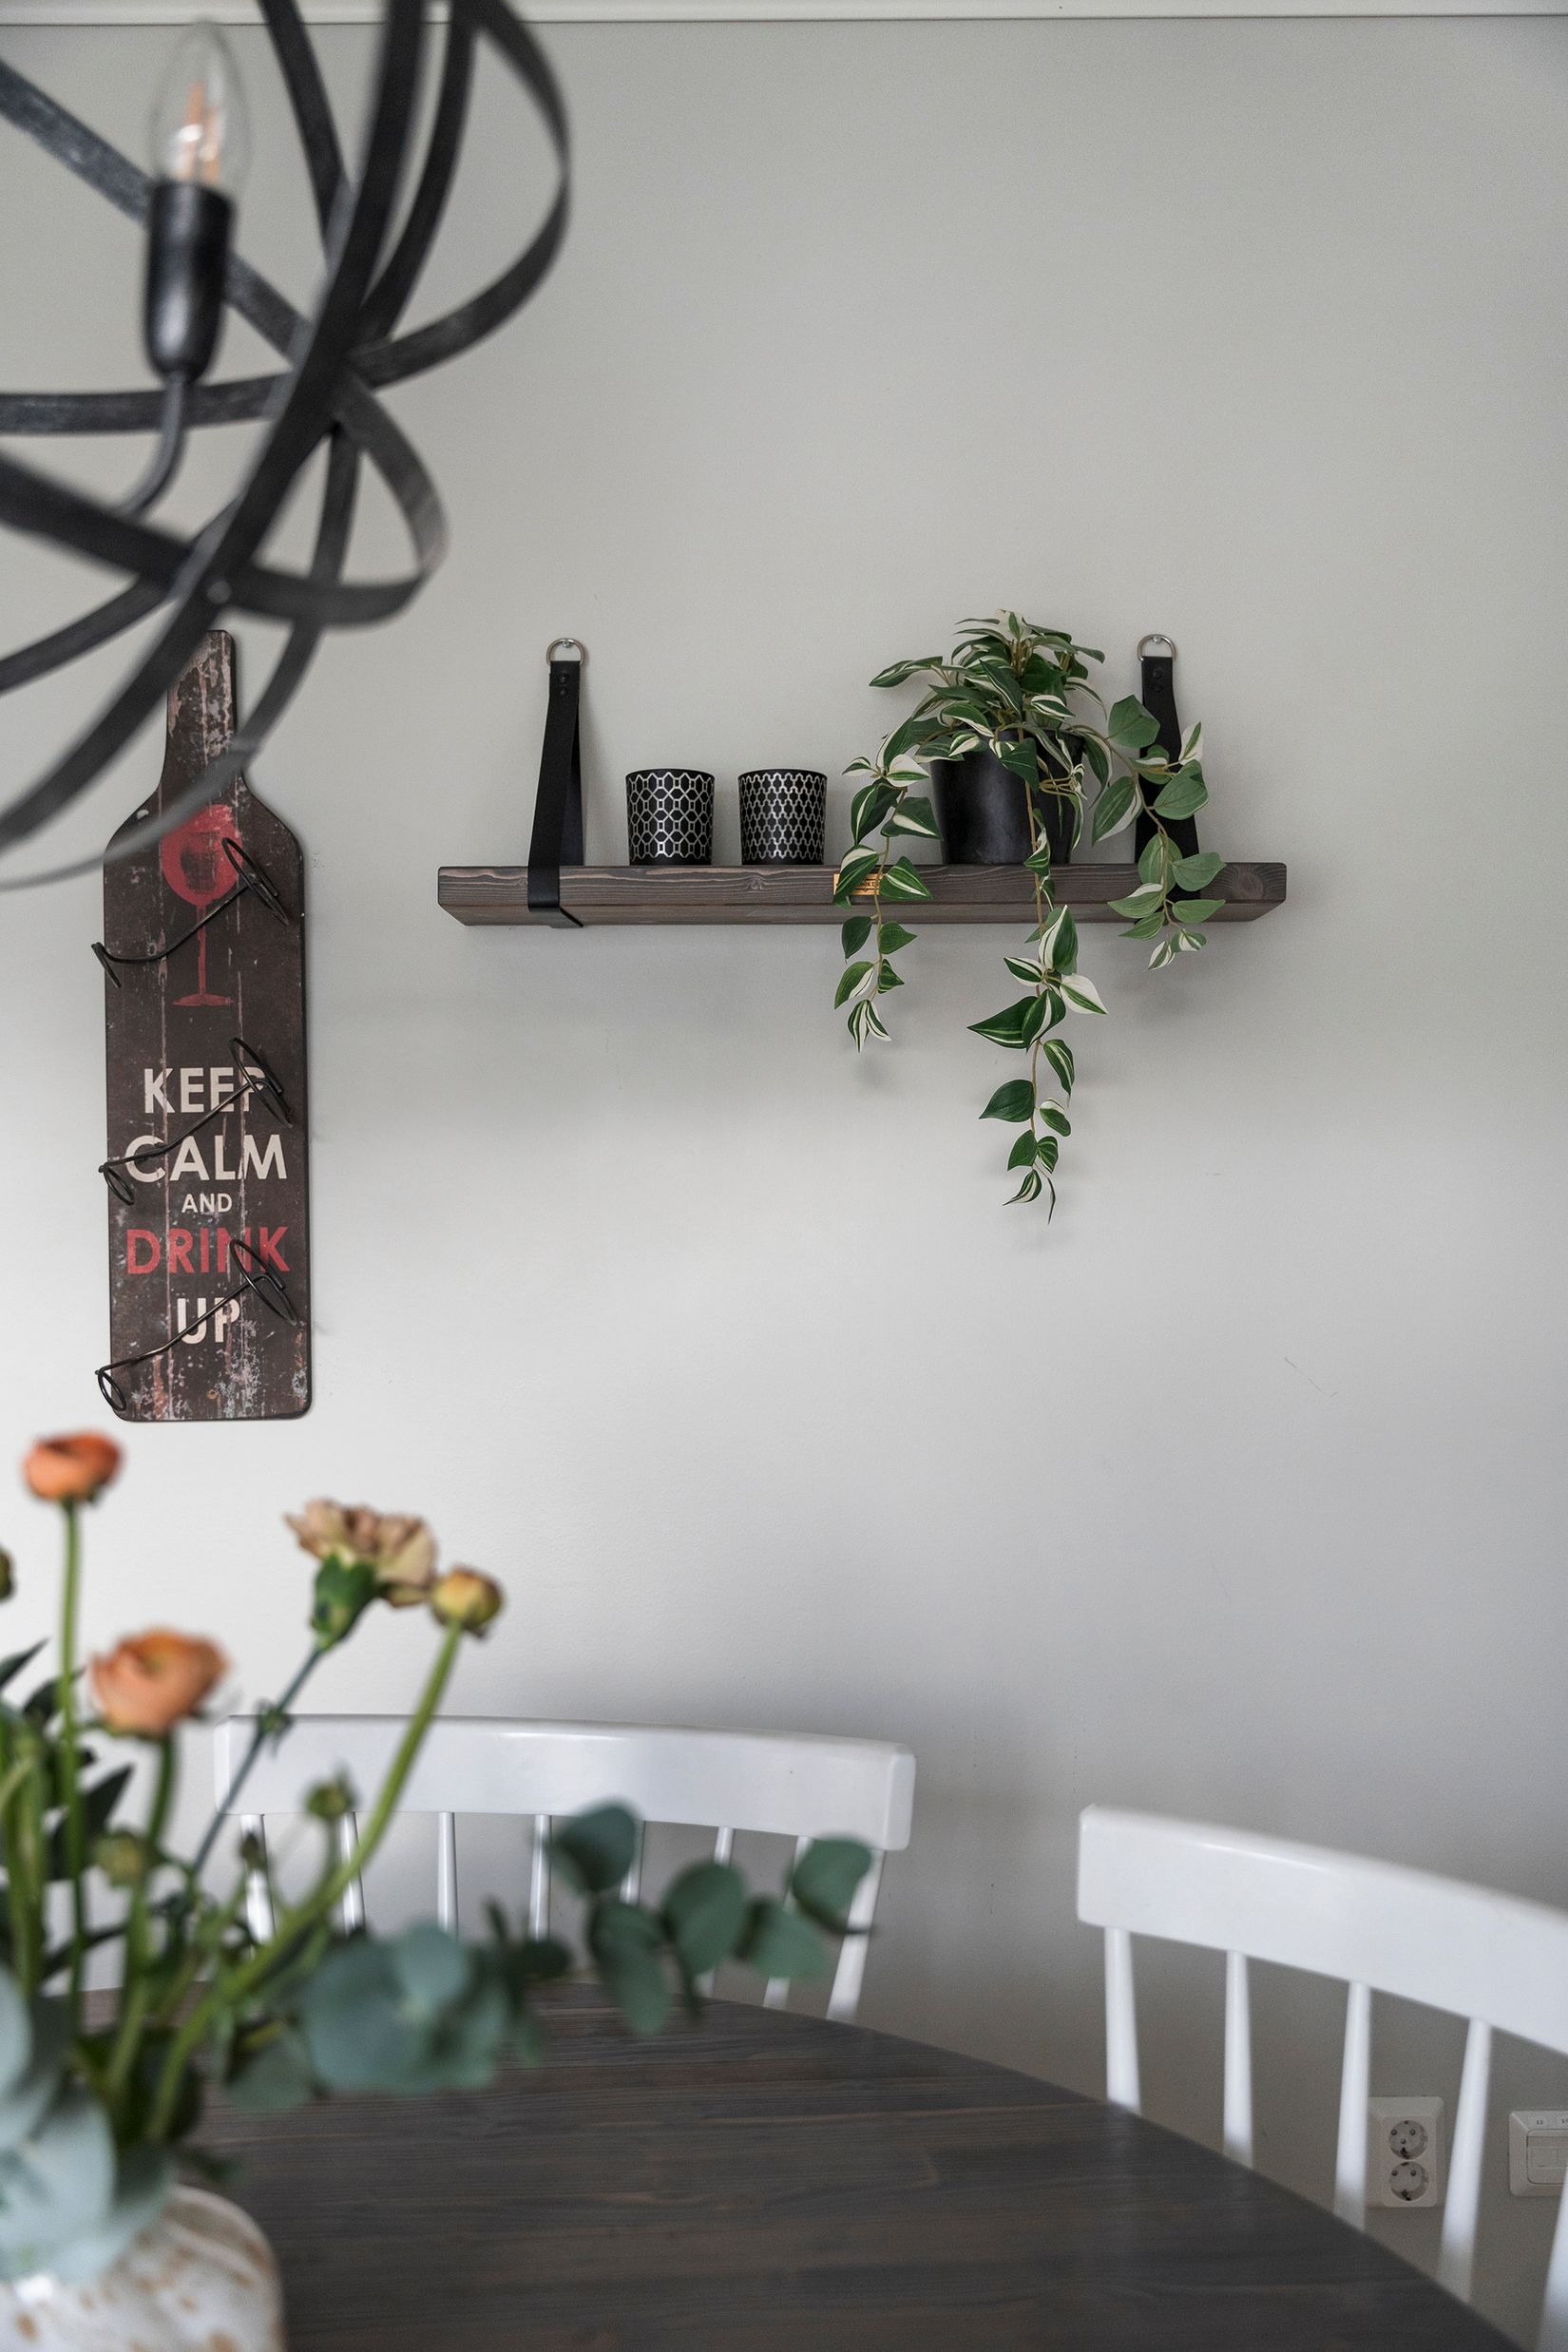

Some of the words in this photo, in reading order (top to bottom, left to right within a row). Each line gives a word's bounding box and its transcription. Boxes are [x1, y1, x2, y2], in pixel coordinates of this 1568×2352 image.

[143, 1066, 267, 1114] KEEP
[124, 1134, 288, 1183] CALM
[181, 1193, 233, 1214] AND
[125, 1226, 291, 1274] DRINK
[177, 1296, 240, 1345] UP
